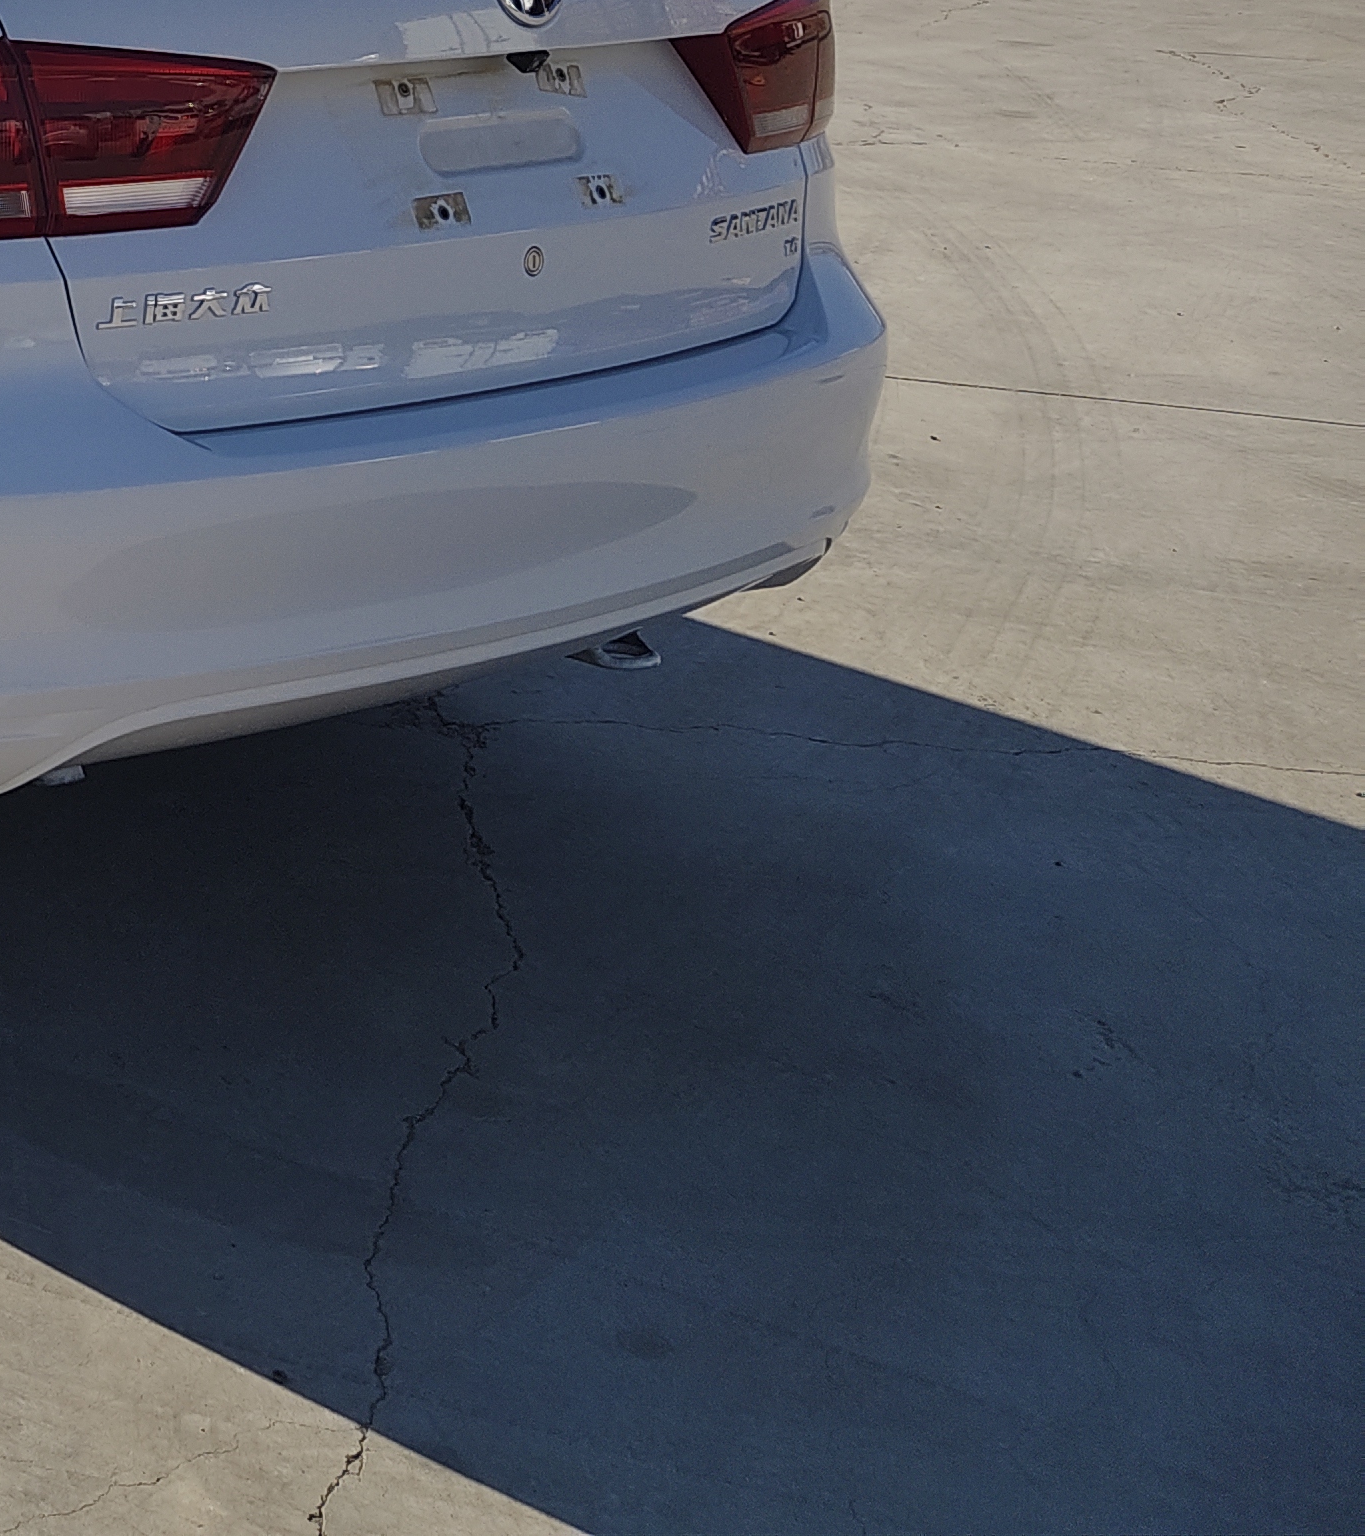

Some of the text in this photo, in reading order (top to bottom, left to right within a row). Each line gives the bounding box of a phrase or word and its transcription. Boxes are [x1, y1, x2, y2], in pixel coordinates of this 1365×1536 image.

[709, 199, 797, 243] SANTANA
[96, 282, 272, 330] 上海大众
